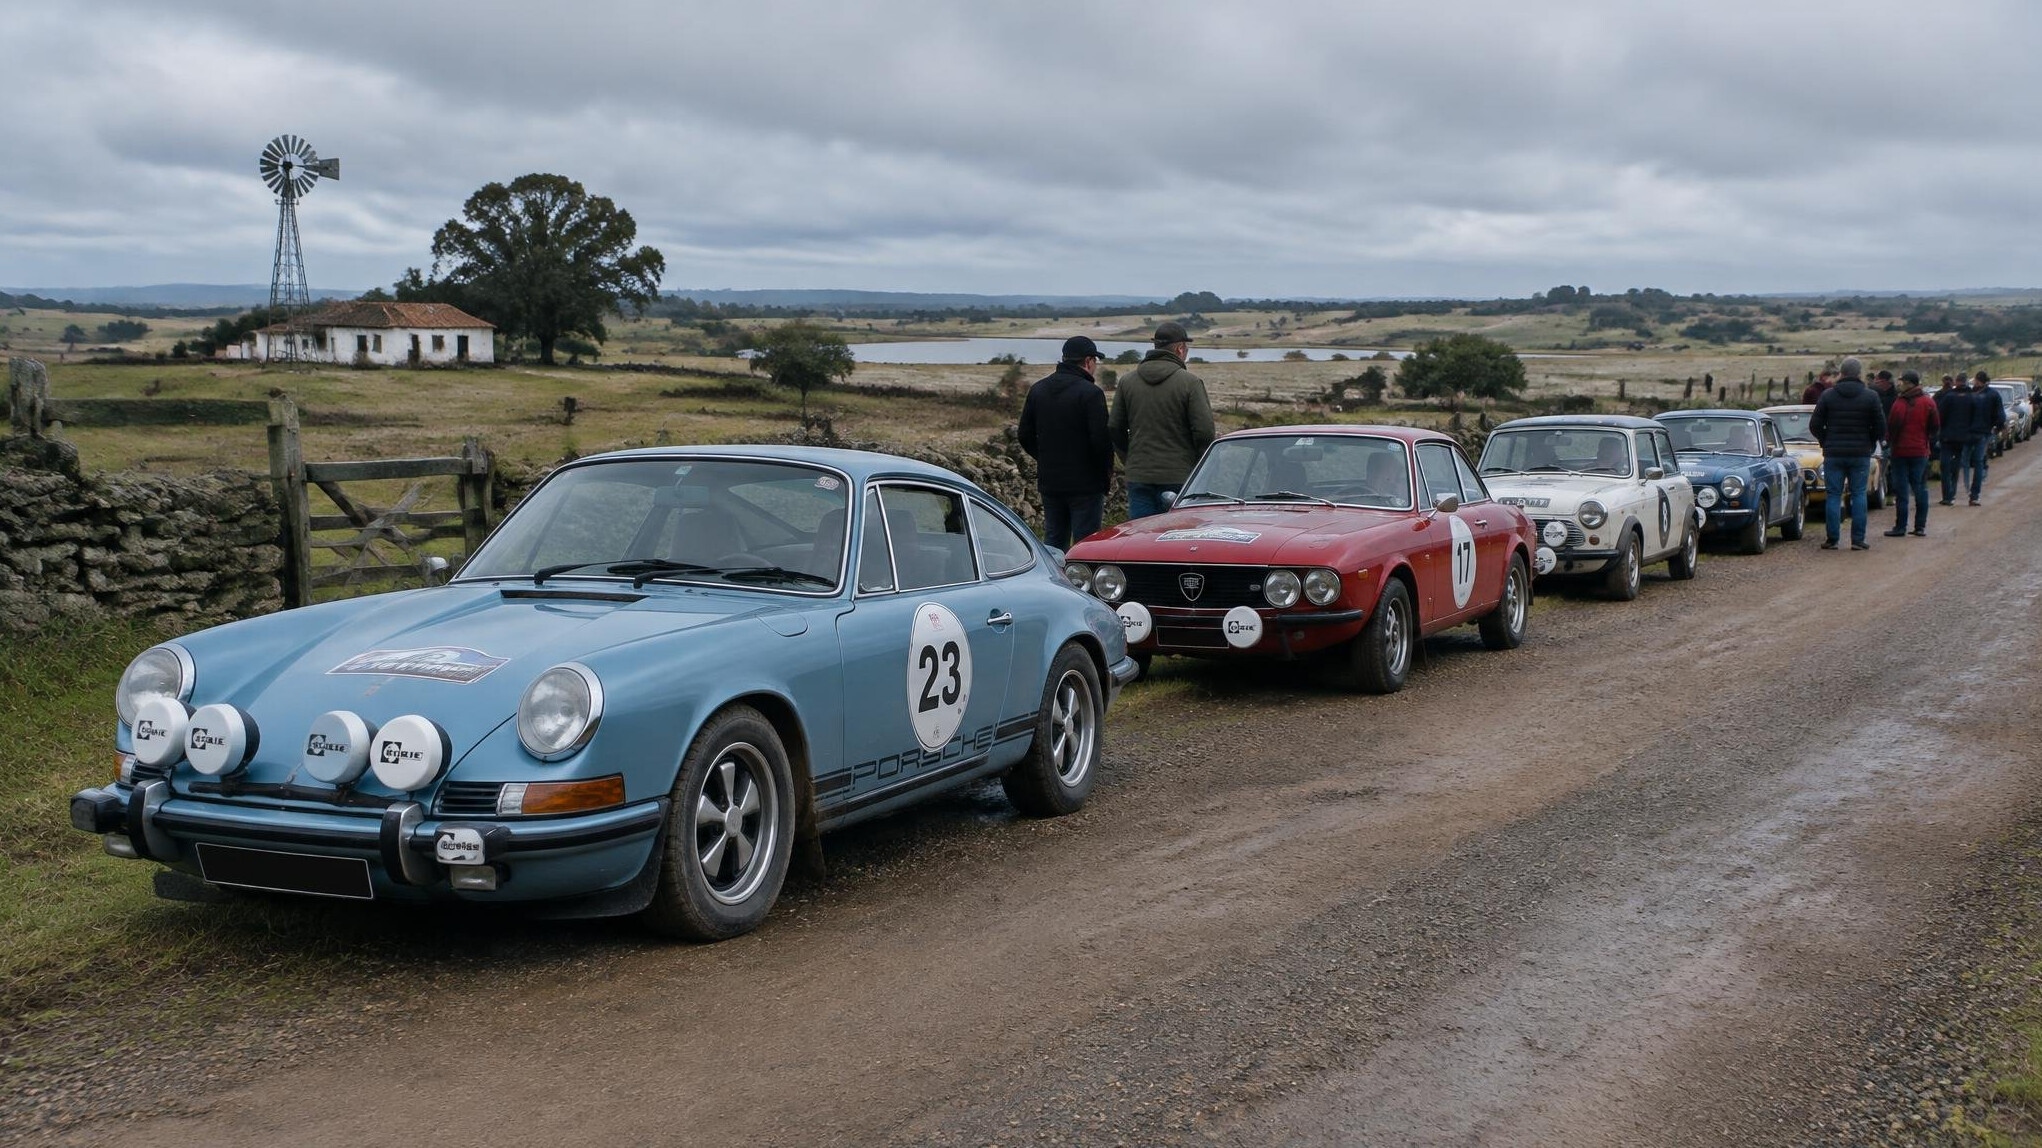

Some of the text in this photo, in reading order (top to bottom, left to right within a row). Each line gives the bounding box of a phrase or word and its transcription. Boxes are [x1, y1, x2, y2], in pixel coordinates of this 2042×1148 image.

[1457, 541, 1470, 584] 17
[918, 641, 961, 713] 23
[852, 724, 993, 789] PORSCHE
